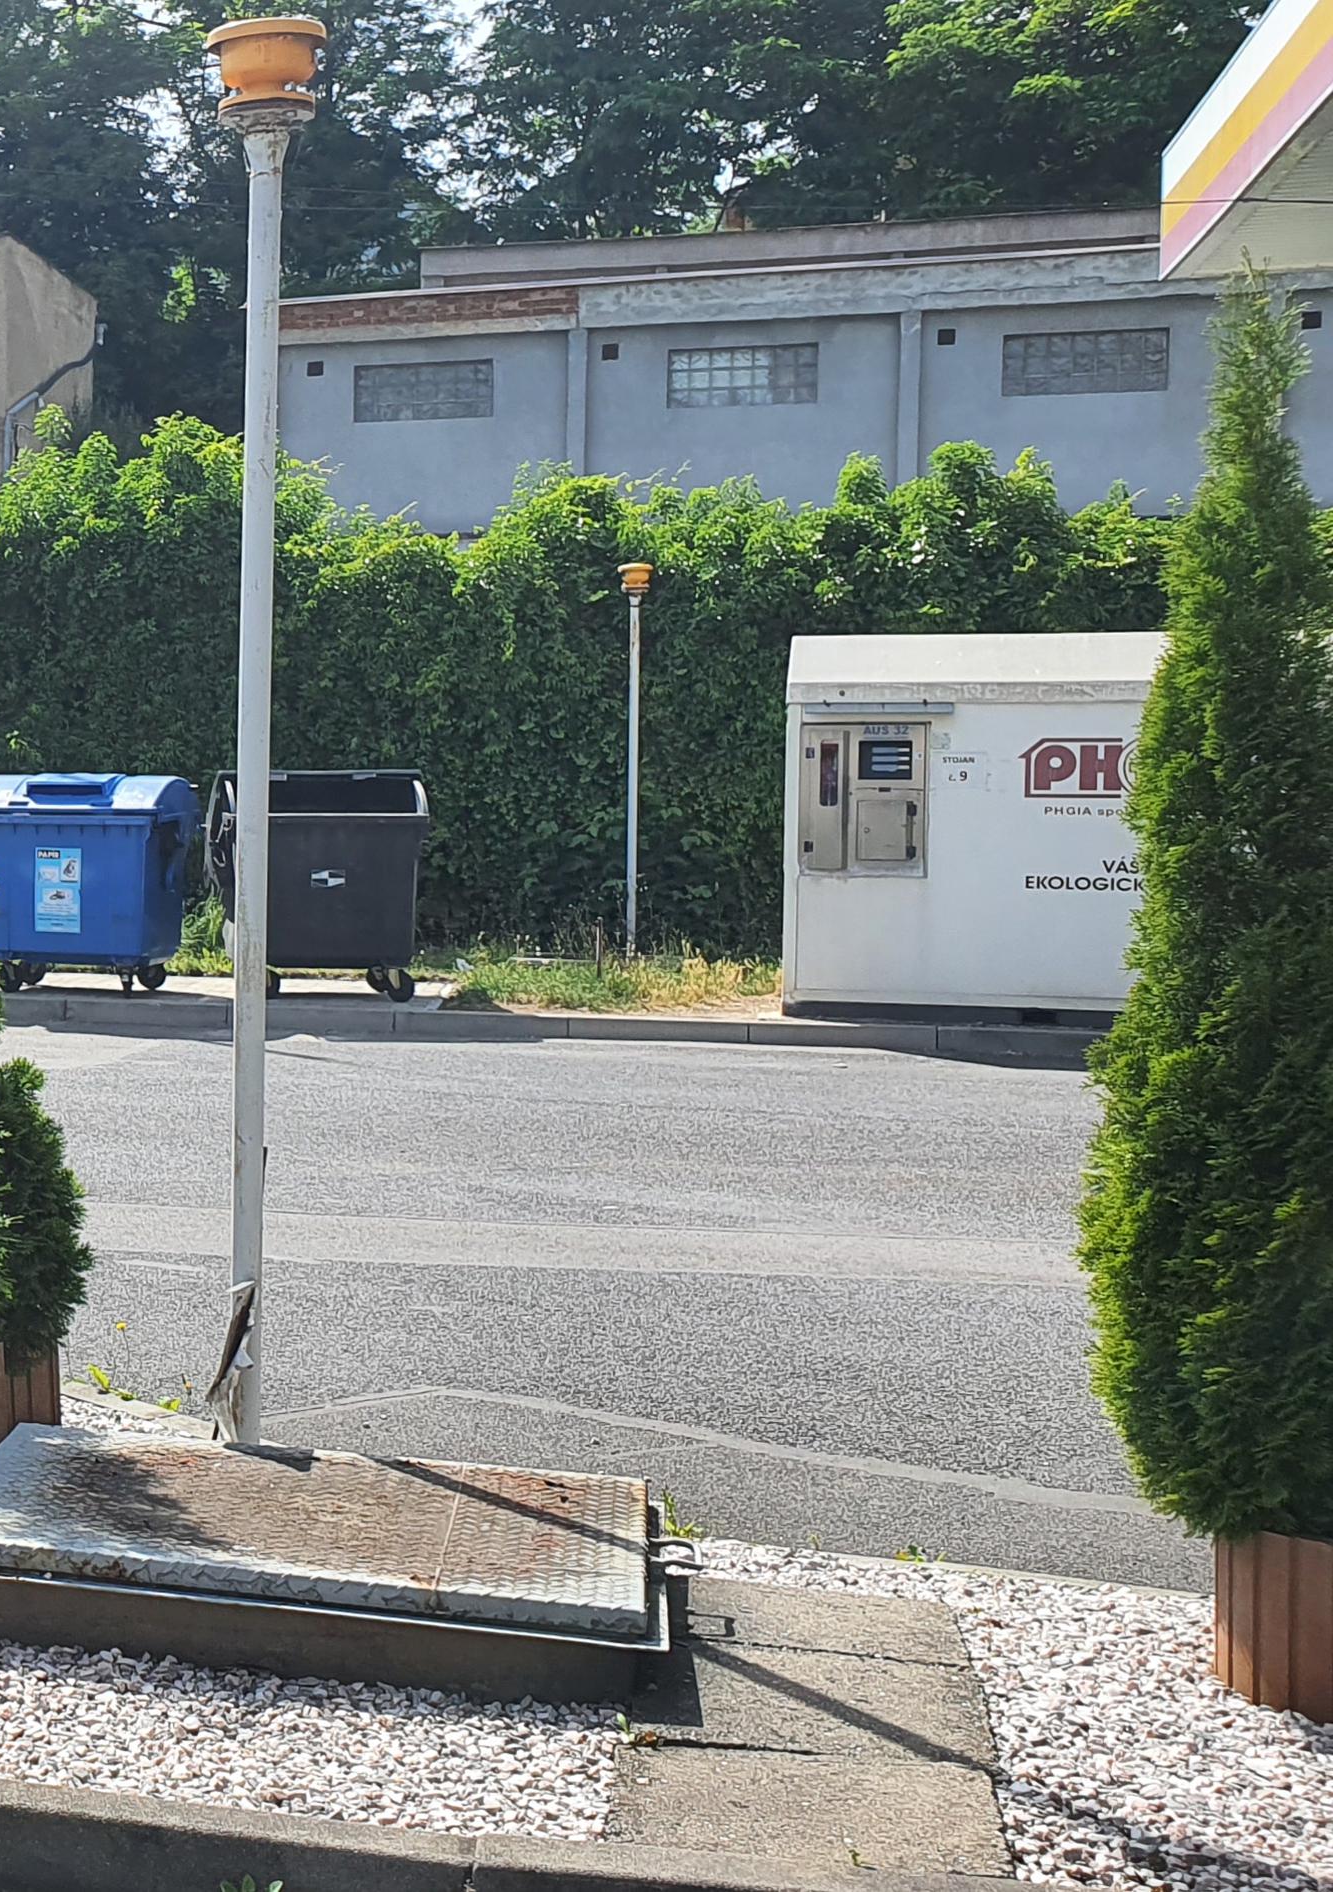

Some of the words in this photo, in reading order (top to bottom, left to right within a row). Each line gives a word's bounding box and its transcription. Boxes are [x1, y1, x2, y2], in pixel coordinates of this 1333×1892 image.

[863, 725, 890, 736] AUS
[893, 725, 910, 736] 32
[942, 756, 975, 764] STOJAN
[959, 770, 968, 781] 9
[1044, 806, 1092, 816] PHGIA
[1102, 855, 1139, 874] VÁŠ
